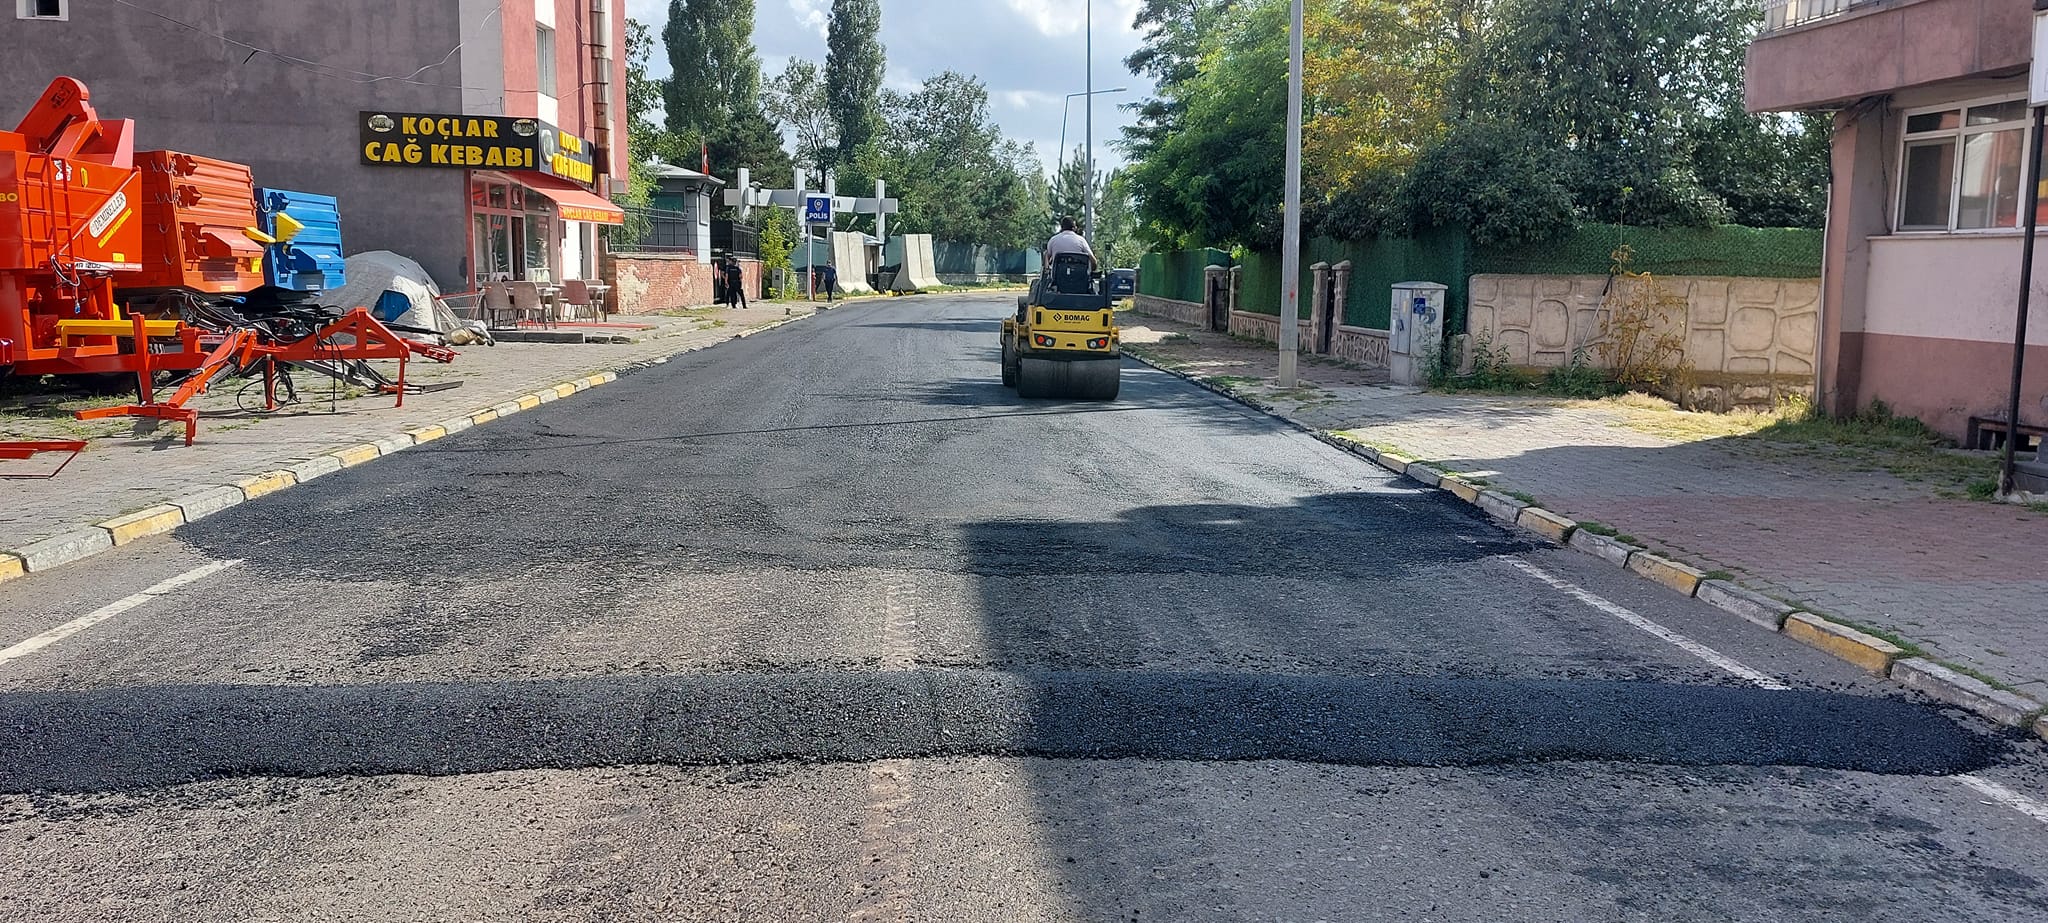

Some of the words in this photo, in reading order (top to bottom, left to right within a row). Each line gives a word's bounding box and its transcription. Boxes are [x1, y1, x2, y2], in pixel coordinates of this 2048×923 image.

[402, 116, 499, 140] KOÇLAR
[365, 138, 423, 164] CAĞ
[431, 144, 533, 168] KEBABI
[809, 211, 828, 220] POLİS
[1064, 314, 1090, 322] BOMAG
